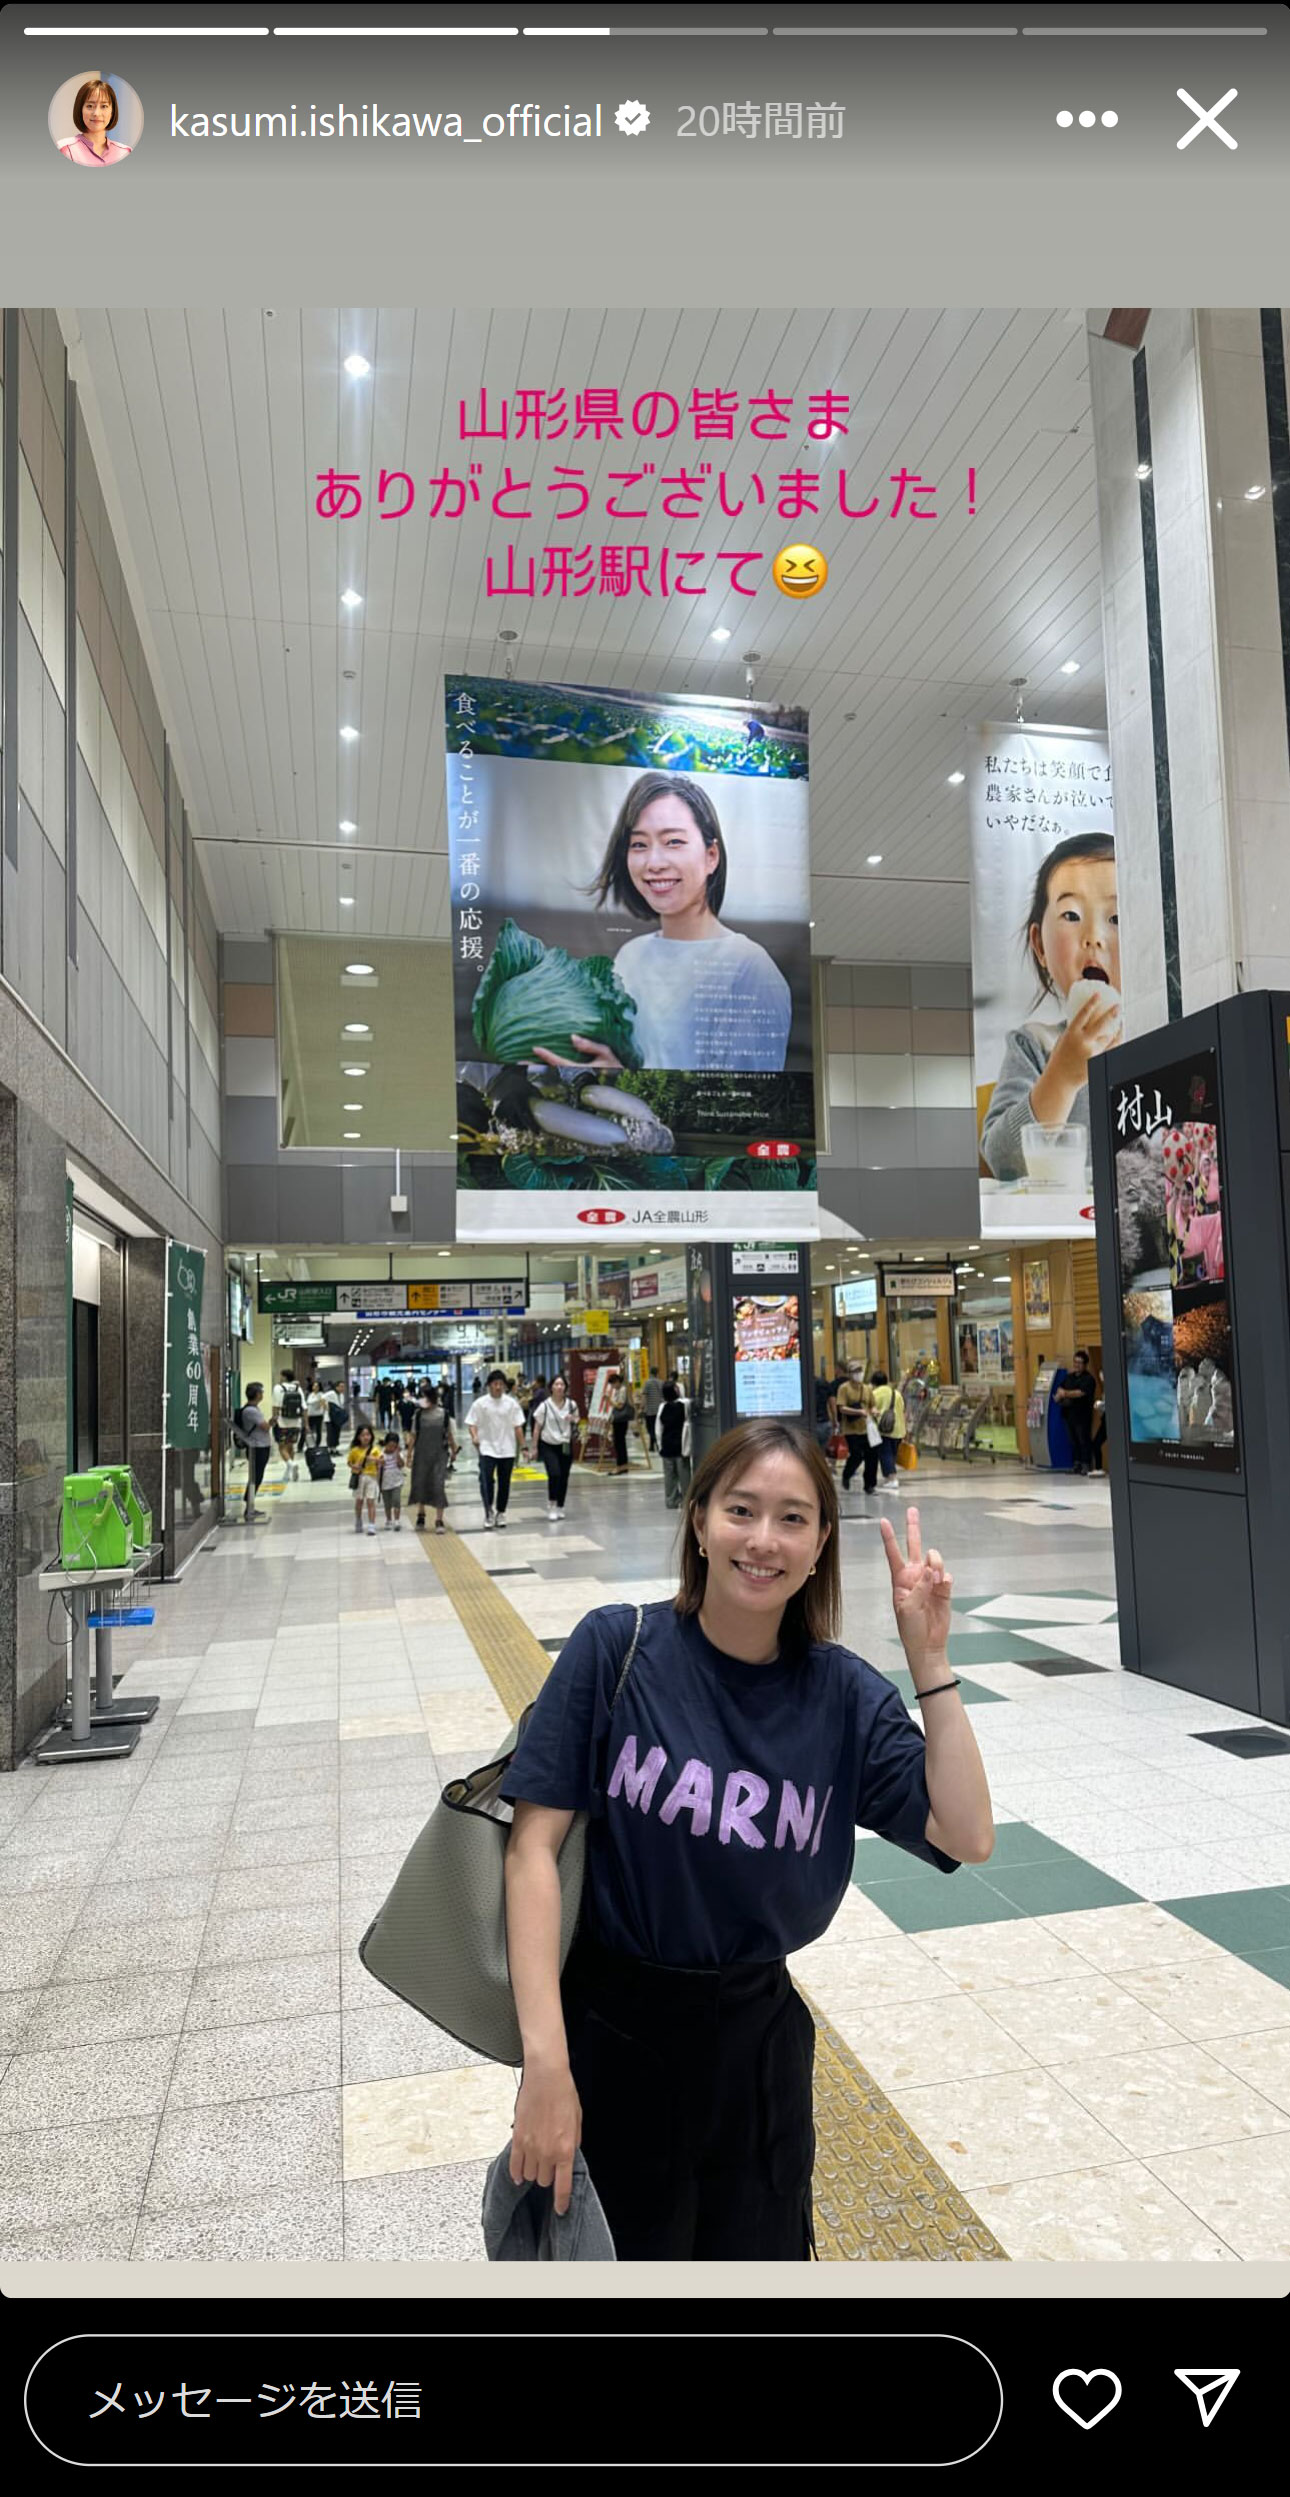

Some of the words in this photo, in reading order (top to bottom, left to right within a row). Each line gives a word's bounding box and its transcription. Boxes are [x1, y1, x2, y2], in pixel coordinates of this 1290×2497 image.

[455, 691, 485, 973] 食べることが一番の応援。
[1116, 1083, 1173, 1137] 村山
[631, 1209, 709, 1224] JA全農山形
[277, 1287, 297, 1299] JR
[607, 1734, 834, 1857] MARNI
